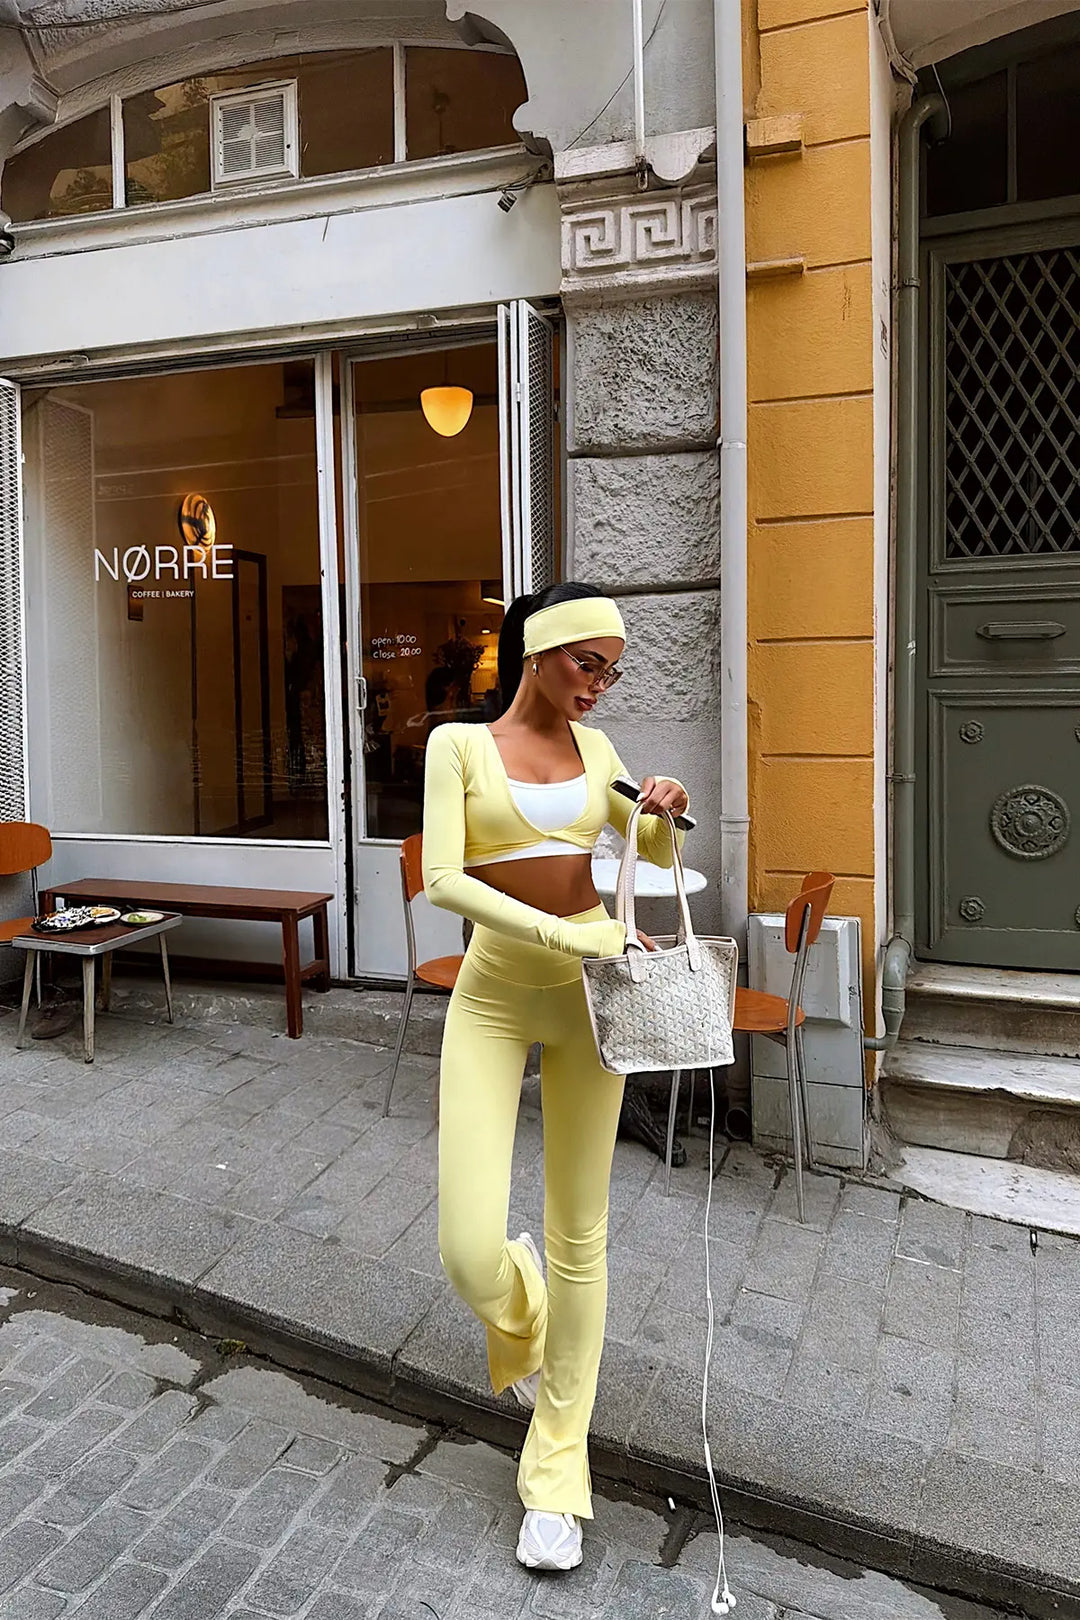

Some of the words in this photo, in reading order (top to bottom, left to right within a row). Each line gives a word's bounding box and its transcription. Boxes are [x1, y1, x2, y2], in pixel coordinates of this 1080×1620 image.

[94, 544, 234, 583] NØRRE
[132, 590, 160, 598] COFFEE
[165, 590, 194, 598] BAKERY
